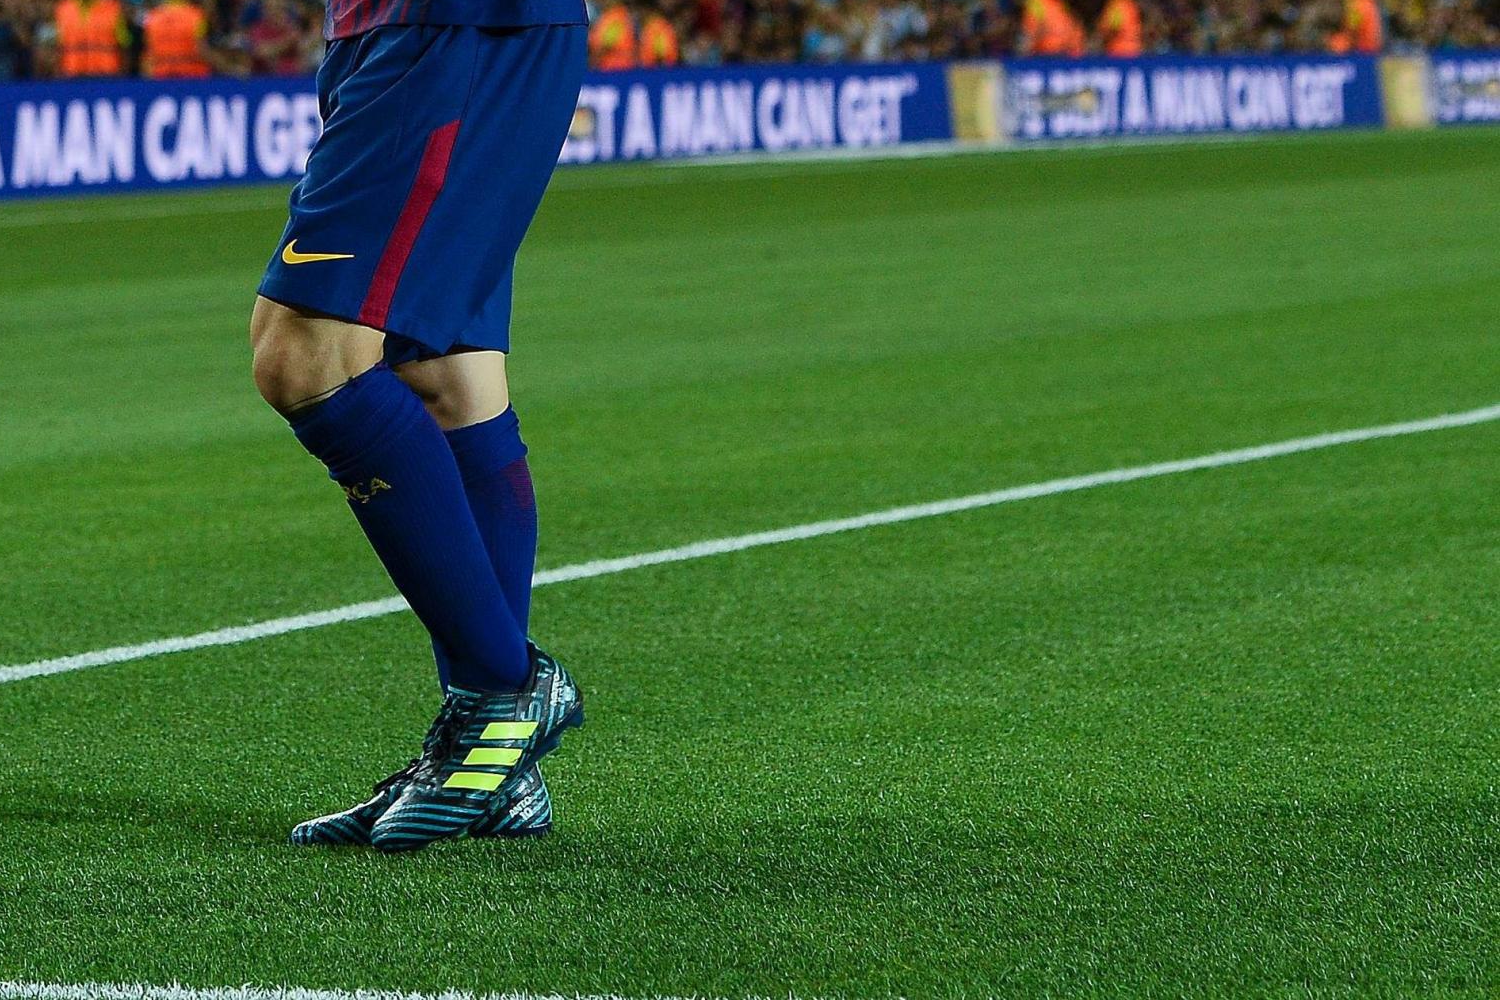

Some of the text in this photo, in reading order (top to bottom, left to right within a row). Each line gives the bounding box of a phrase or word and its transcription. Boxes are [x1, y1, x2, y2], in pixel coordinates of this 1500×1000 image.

[11, 99, 137, 190] MAN
[142, 96, 248, 183] CAN
[253, 93, 319, 178] GE
[659, 80, 755, 158] MAN
